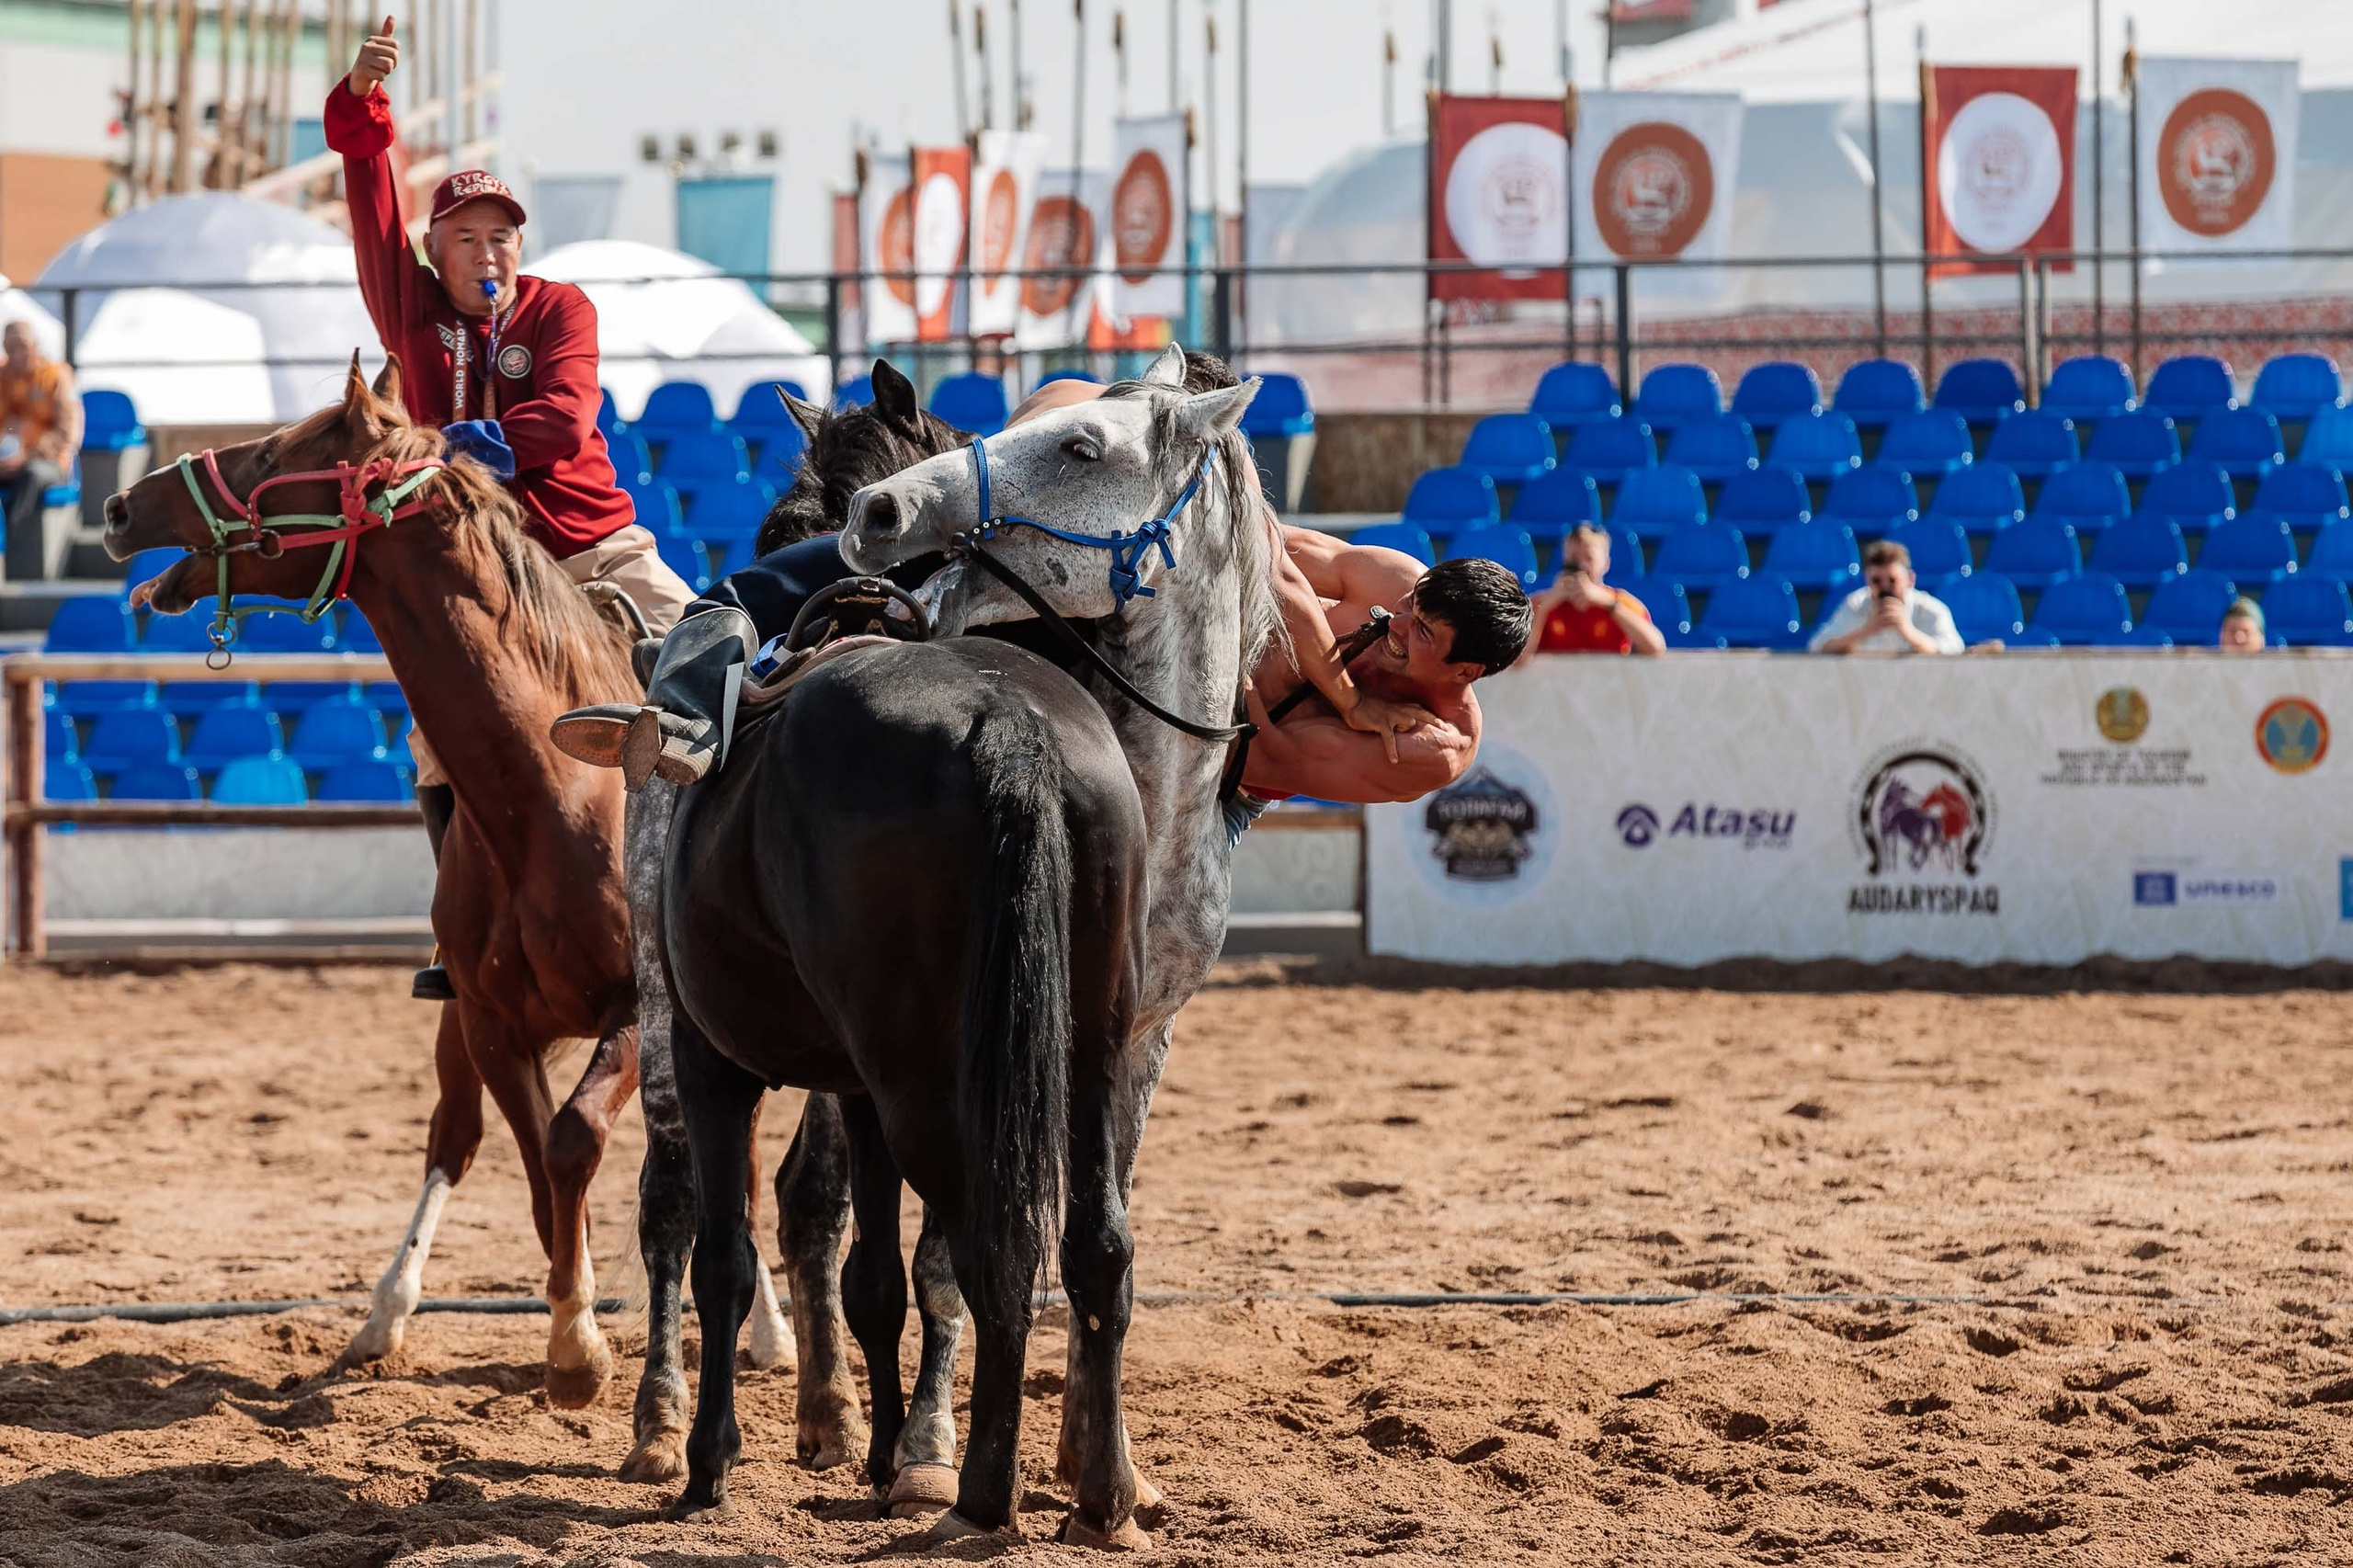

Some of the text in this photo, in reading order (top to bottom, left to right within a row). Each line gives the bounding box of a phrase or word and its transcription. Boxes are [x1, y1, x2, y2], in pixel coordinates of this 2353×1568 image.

[456, 328, 466, 367] NOMAD
[455, 369, 465, 409] WORLD
[1669, 801, 1797, 837] Atasu
[1848, 885, 1999, 914] AUDARYSPAQ
[2185, 880, 2277, 900] unesco
